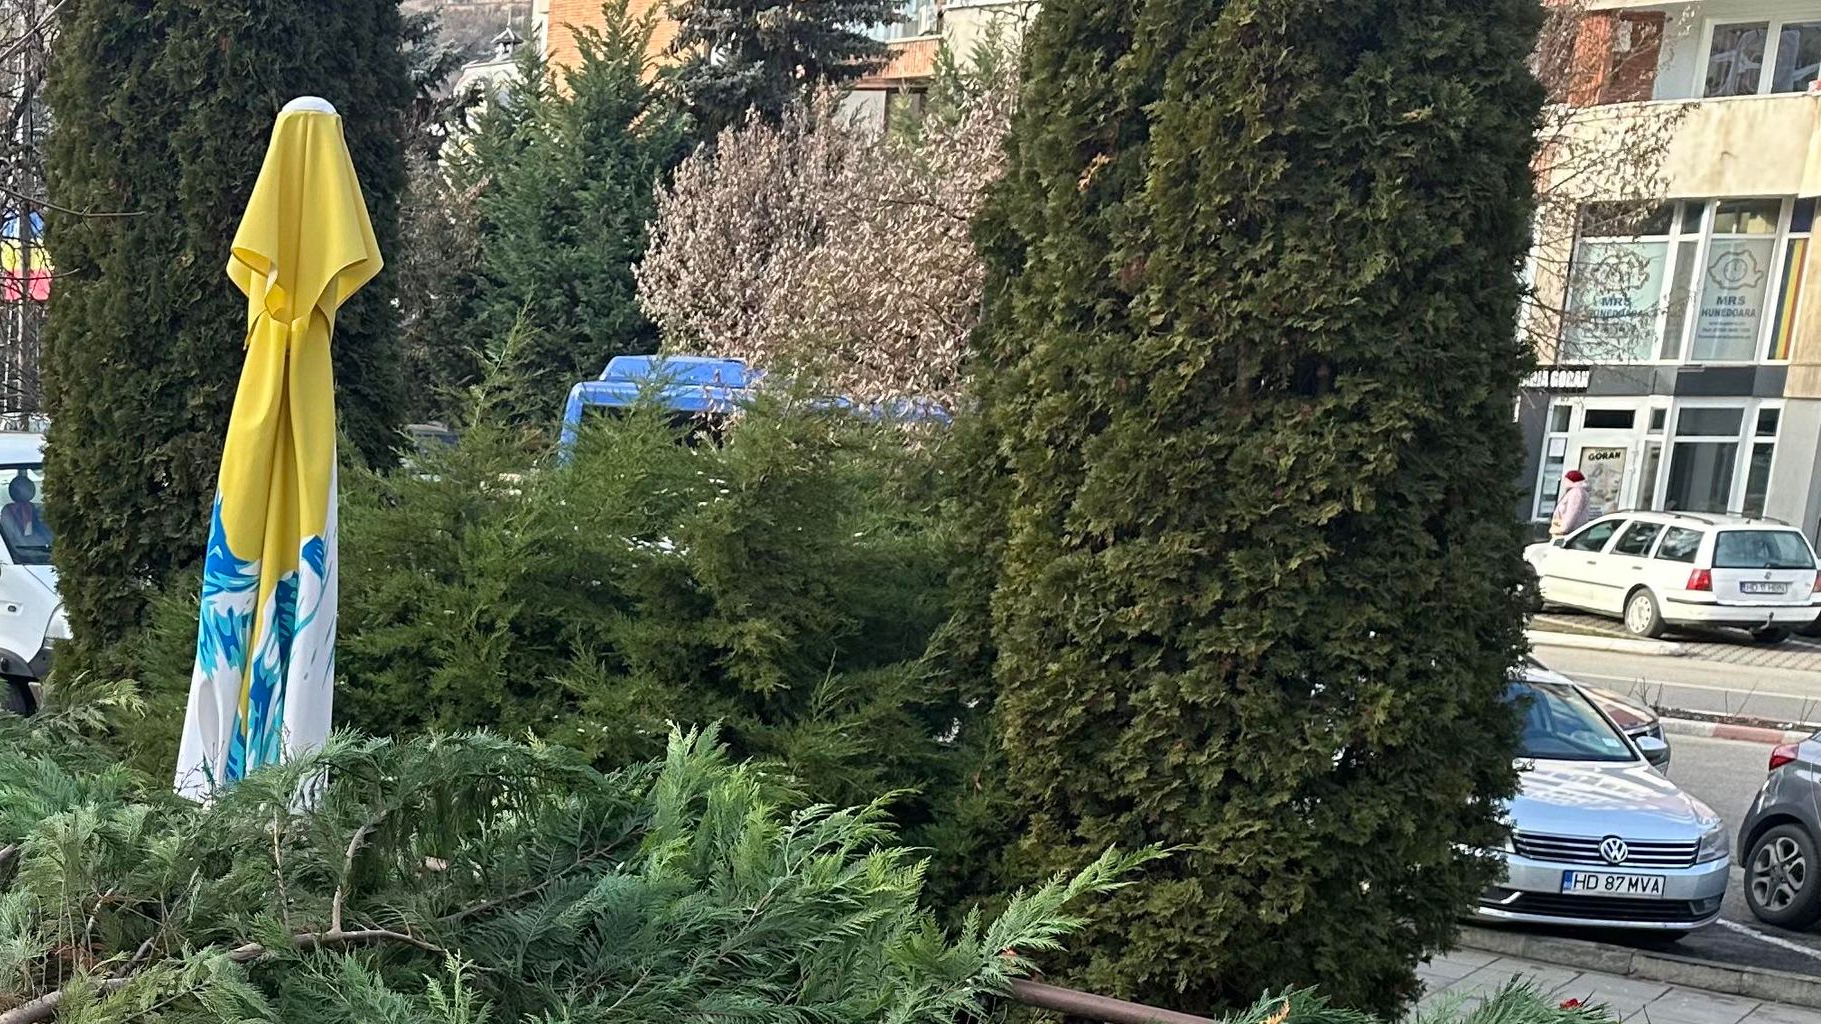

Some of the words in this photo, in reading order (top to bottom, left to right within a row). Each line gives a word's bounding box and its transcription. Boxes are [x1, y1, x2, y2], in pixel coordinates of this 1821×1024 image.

[1716, 295, 1746, 305] MRS
[1701, 308, 1756, 317] HUNEDOARA
[1588, 451, 1622, 461] GORAN
[1573, 873, 1599, 890] HD
[1604, 875, 1626, 891] 87
[1627, 876, 1660, 893] MVA
